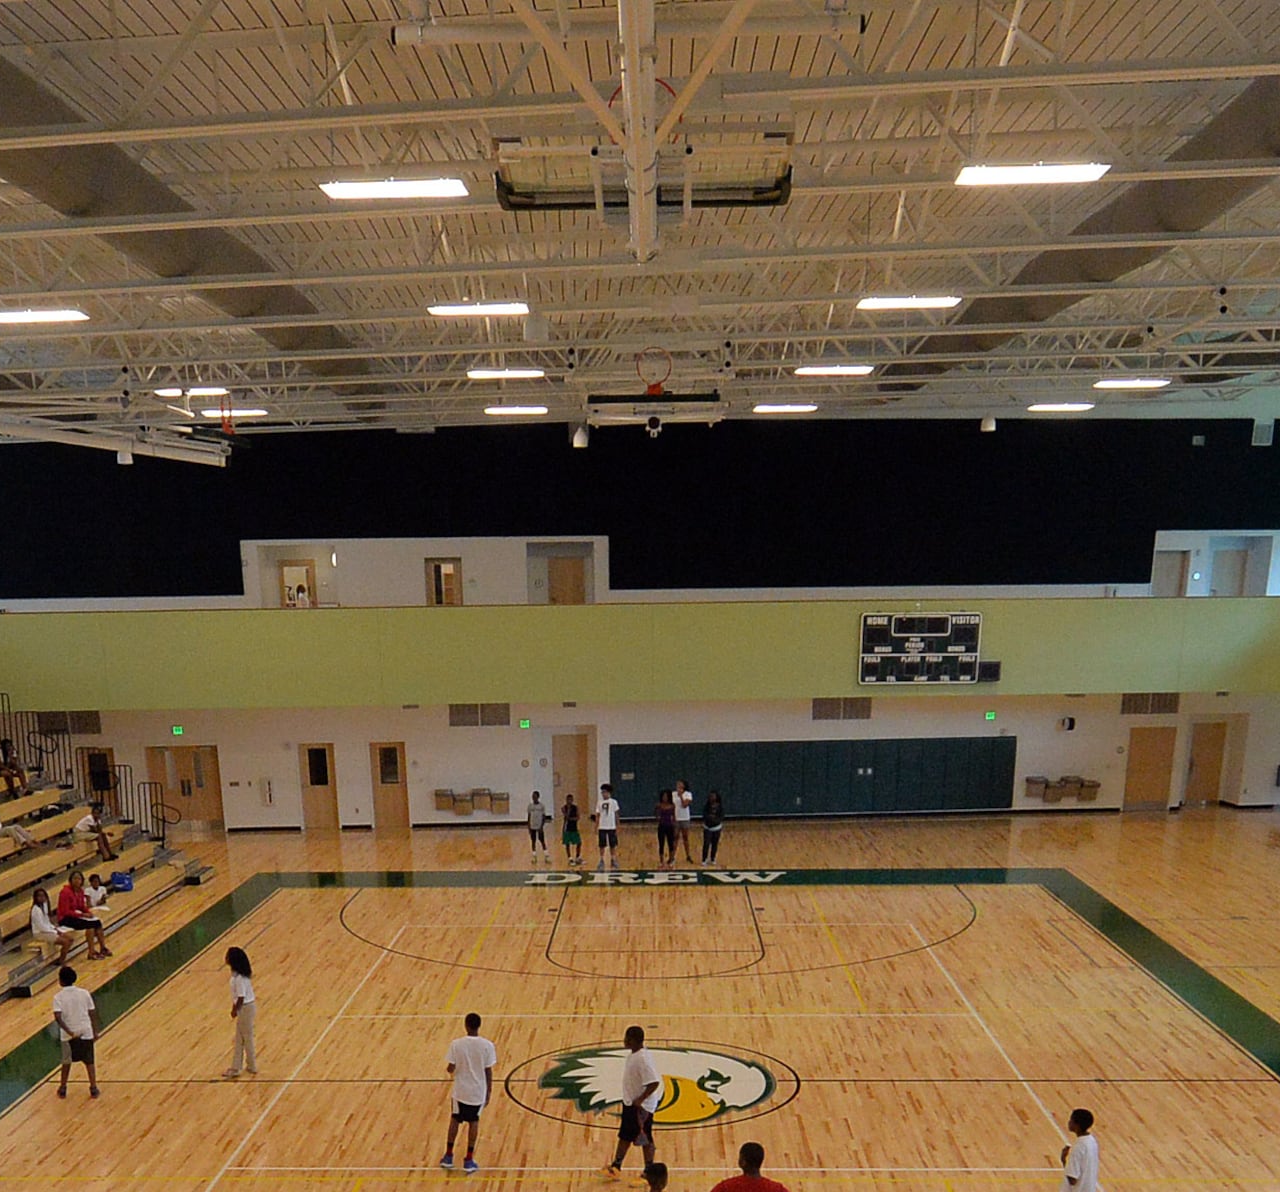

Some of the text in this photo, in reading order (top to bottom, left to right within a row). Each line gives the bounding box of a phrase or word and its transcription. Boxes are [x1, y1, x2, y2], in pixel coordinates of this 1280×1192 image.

[866, 616, 888, 625] HOME
[952, 616, 980, 624] VISITOR
[524, 871, 787, 885] DREW
